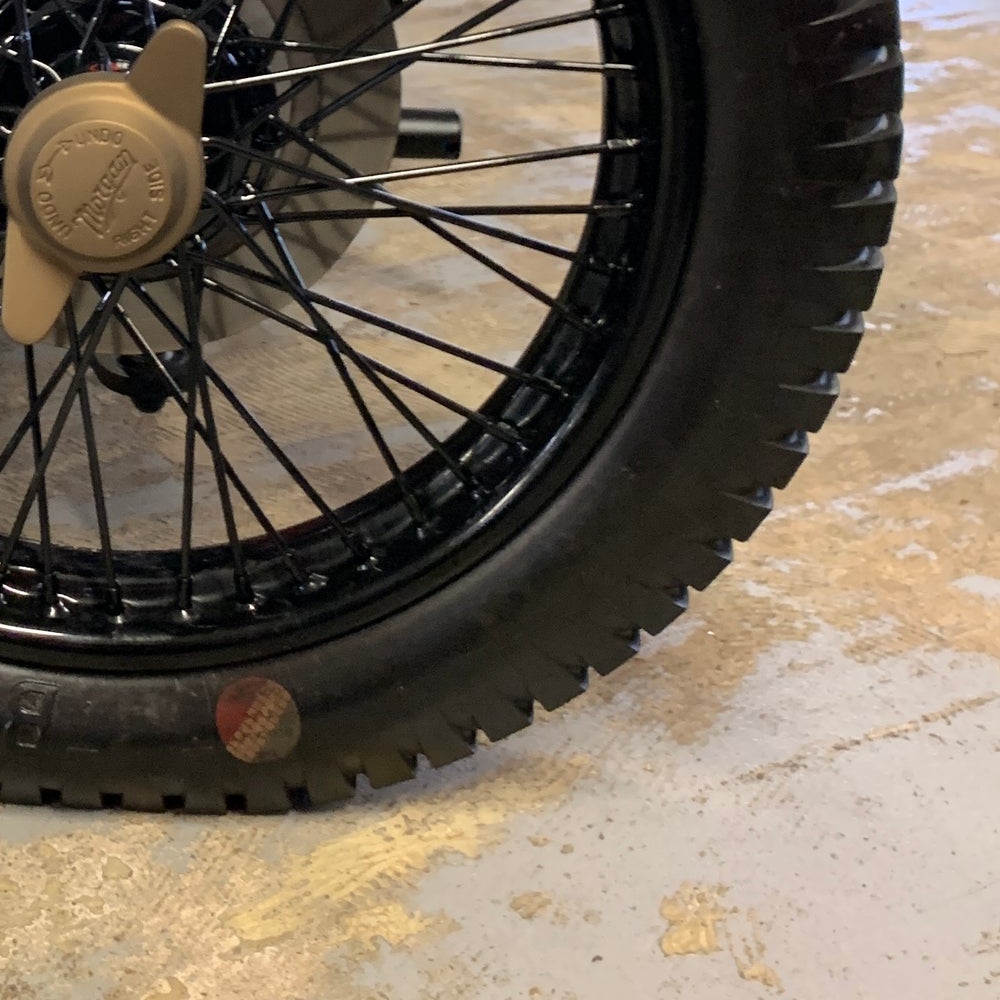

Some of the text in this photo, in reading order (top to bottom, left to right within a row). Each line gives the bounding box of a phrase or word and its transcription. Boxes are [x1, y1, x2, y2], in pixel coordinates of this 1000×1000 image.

[74, 127, 124, 148] UNDO
[142, 161, 165, 202] SIDE
[37, 192, 72, 240] UNDO
